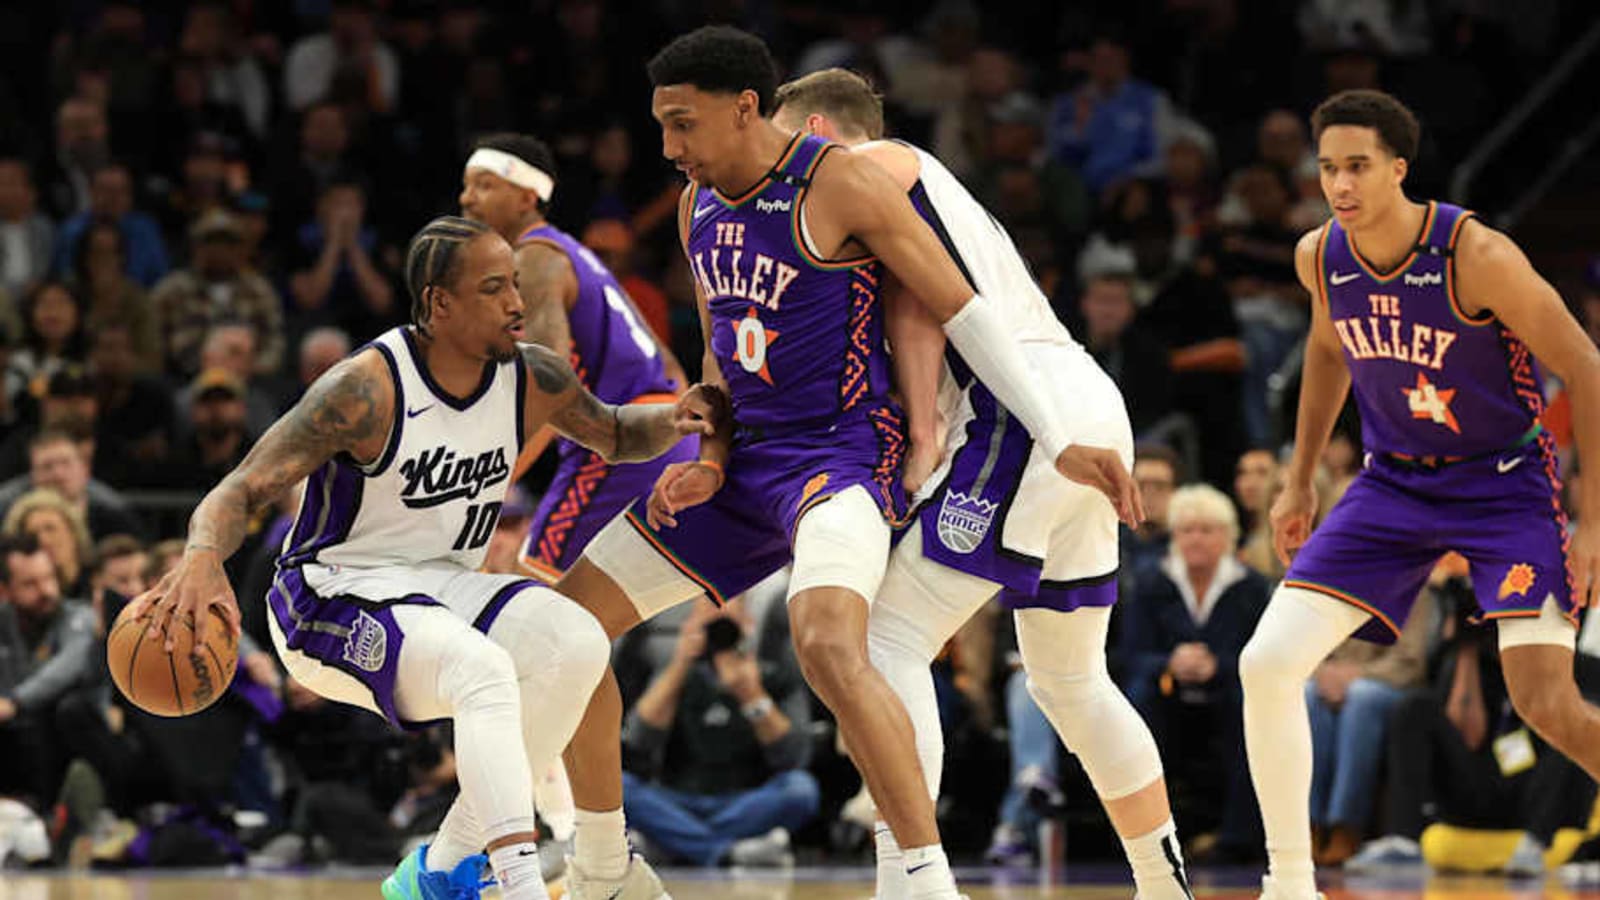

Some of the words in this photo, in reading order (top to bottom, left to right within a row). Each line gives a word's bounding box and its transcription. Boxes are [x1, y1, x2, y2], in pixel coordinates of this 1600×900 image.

[756, 199, 791, 214] PayPal
[716, 223, 745, 246] THE
[690, 248, 800, 311] ALLEY
[1368, 294, 1400, 316] THE
[736, 317, 767, 373] 0
[1408, 383, 1448, 423] 4
[398, 446, 509, 508] Kings
[452, 501, 503, 550] 10
[940, 511, 986, 535] KINGS
